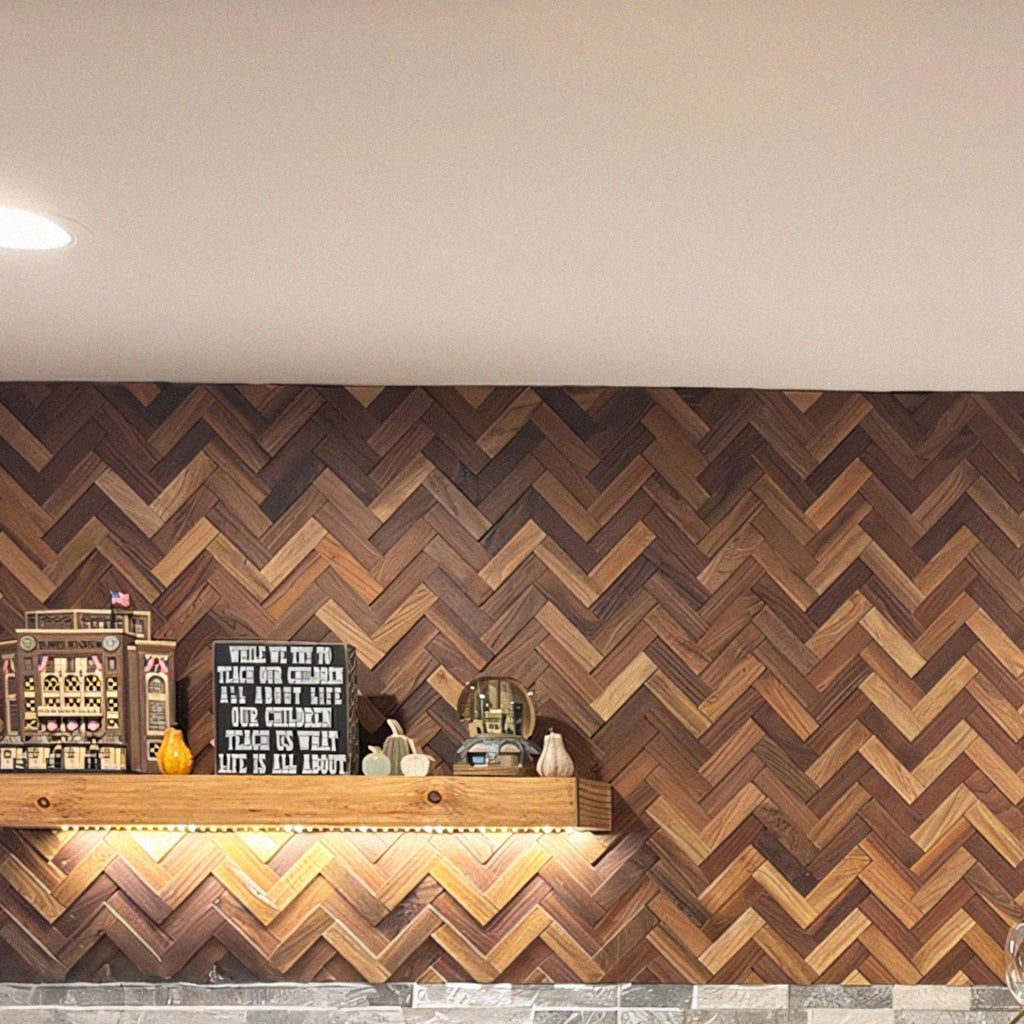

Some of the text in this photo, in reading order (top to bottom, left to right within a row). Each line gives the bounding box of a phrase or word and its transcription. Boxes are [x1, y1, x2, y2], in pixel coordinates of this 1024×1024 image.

[229, 645, 333, 665] WHILE WE TRY TO
[217, 665, 344, 685] TEACH OUR CHILDREN
[219, 686, 343, 705] ALL ABOUT LIFE
[231, 706, 332, 728] OUR CHILDREN
[225, 729, 339, 752] TEACH US WHAT
[218, 753, 347, 775] LIFE IS ALL ABOUT
